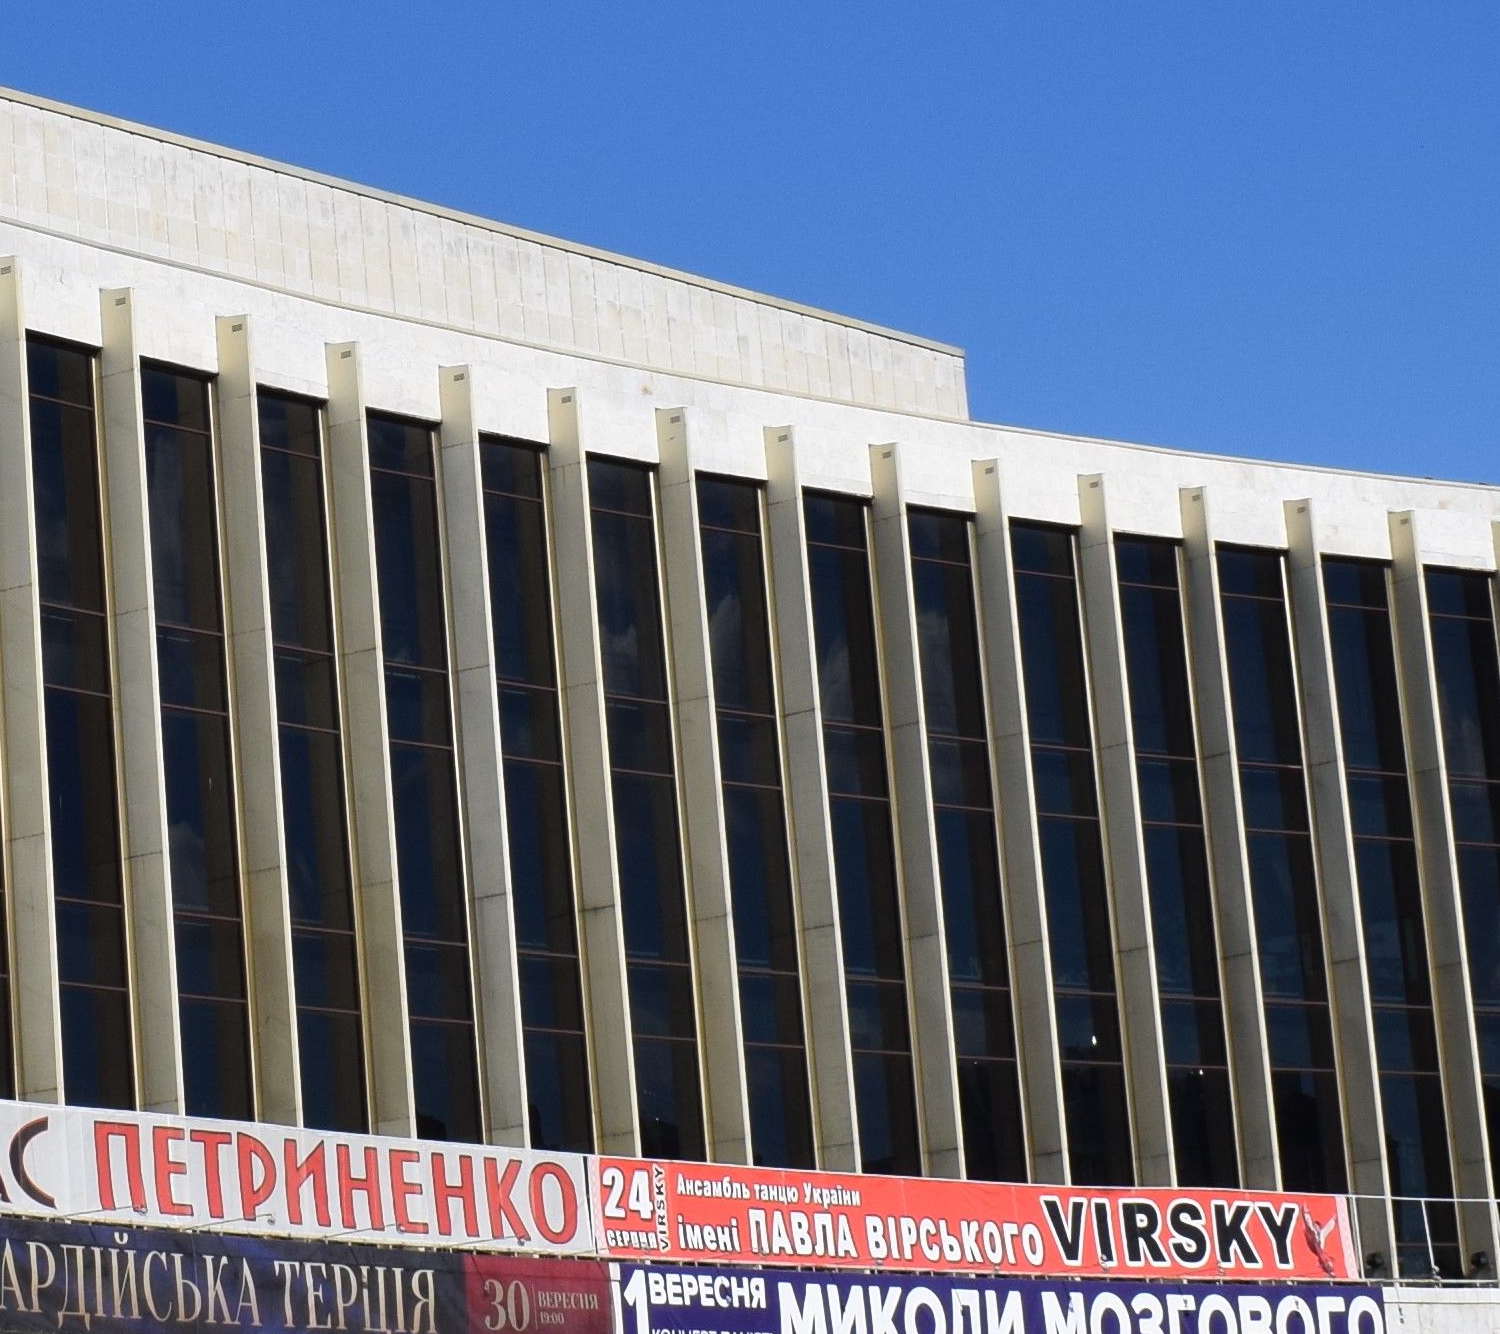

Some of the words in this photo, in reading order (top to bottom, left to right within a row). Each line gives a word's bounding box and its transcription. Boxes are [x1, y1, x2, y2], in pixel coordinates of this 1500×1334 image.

[94, 1120, 579, 1245] ПЕТРИНЕНКО
[602, 1167, 654, 1219] 24
[653, 1164, 670, 1252] VIRSKY
[676, 1173, 750, 1200] Ансамбль
[754, 1183, 799, 1205] танцю
[803, 1182, 862, 1209] України
[606, 1229, 658, 1250] СЕРПНЯ
[677, 1214, 741, 1252] імені
[748, 1208, 859, 1258] ПАВЛА
[865, 1214, 1045, 1267] ВІРСЬКОГО
[1038, 1194, 1301, 1271] VIRSKY
[484, 1279, 530, 1332] 30
[537, 1290, 599, 1310] ВЕРЕСНЯ
[648, 1272, 767, 1309] ВЕРЕСНЯ
